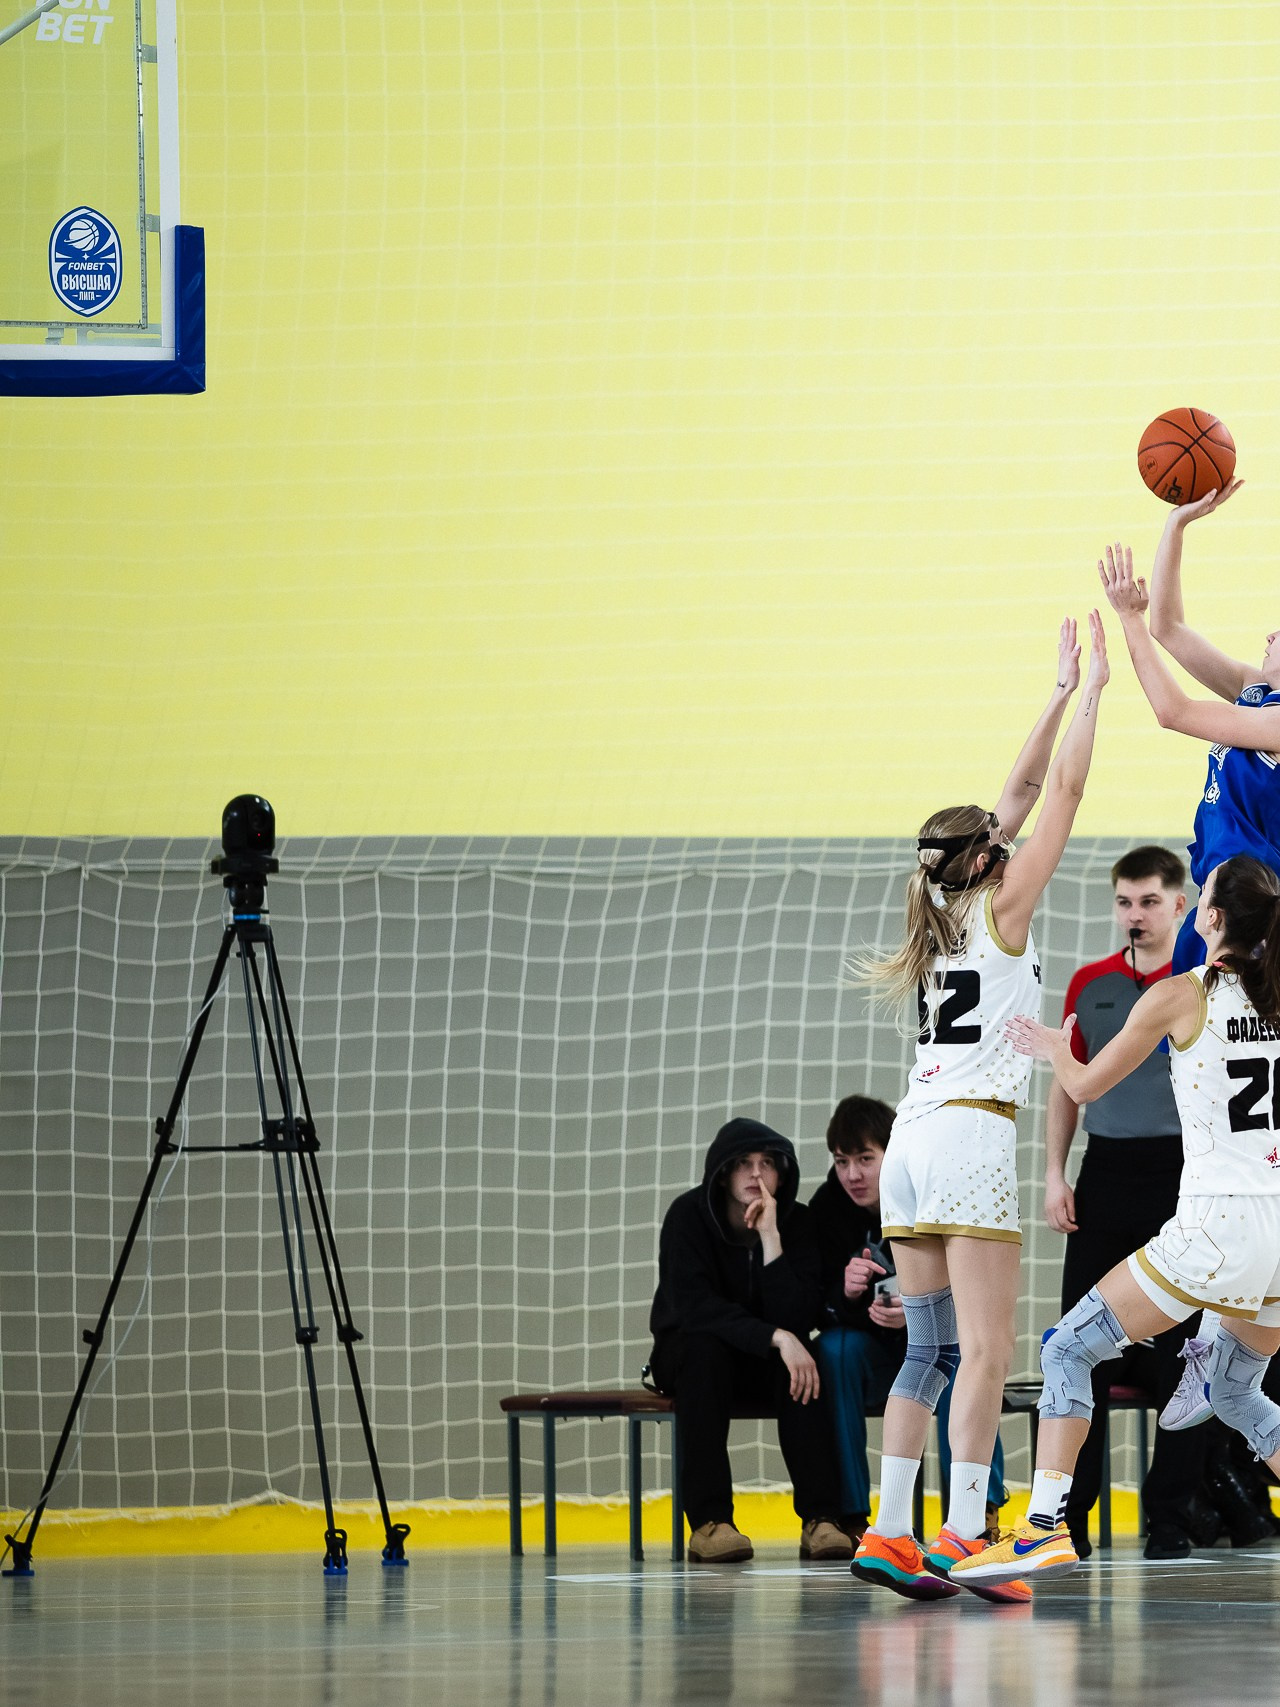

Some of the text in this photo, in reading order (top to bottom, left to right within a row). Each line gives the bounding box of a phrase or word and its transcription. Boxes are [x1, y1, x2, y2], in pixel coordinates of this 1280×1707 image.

[35, 11, 114, 45] BET
[68, 262, 106, 271] FONBET
[61, 274, 111, 291] ВЫСШАЯ
[79, 291, 95, 301] ЛИГА
